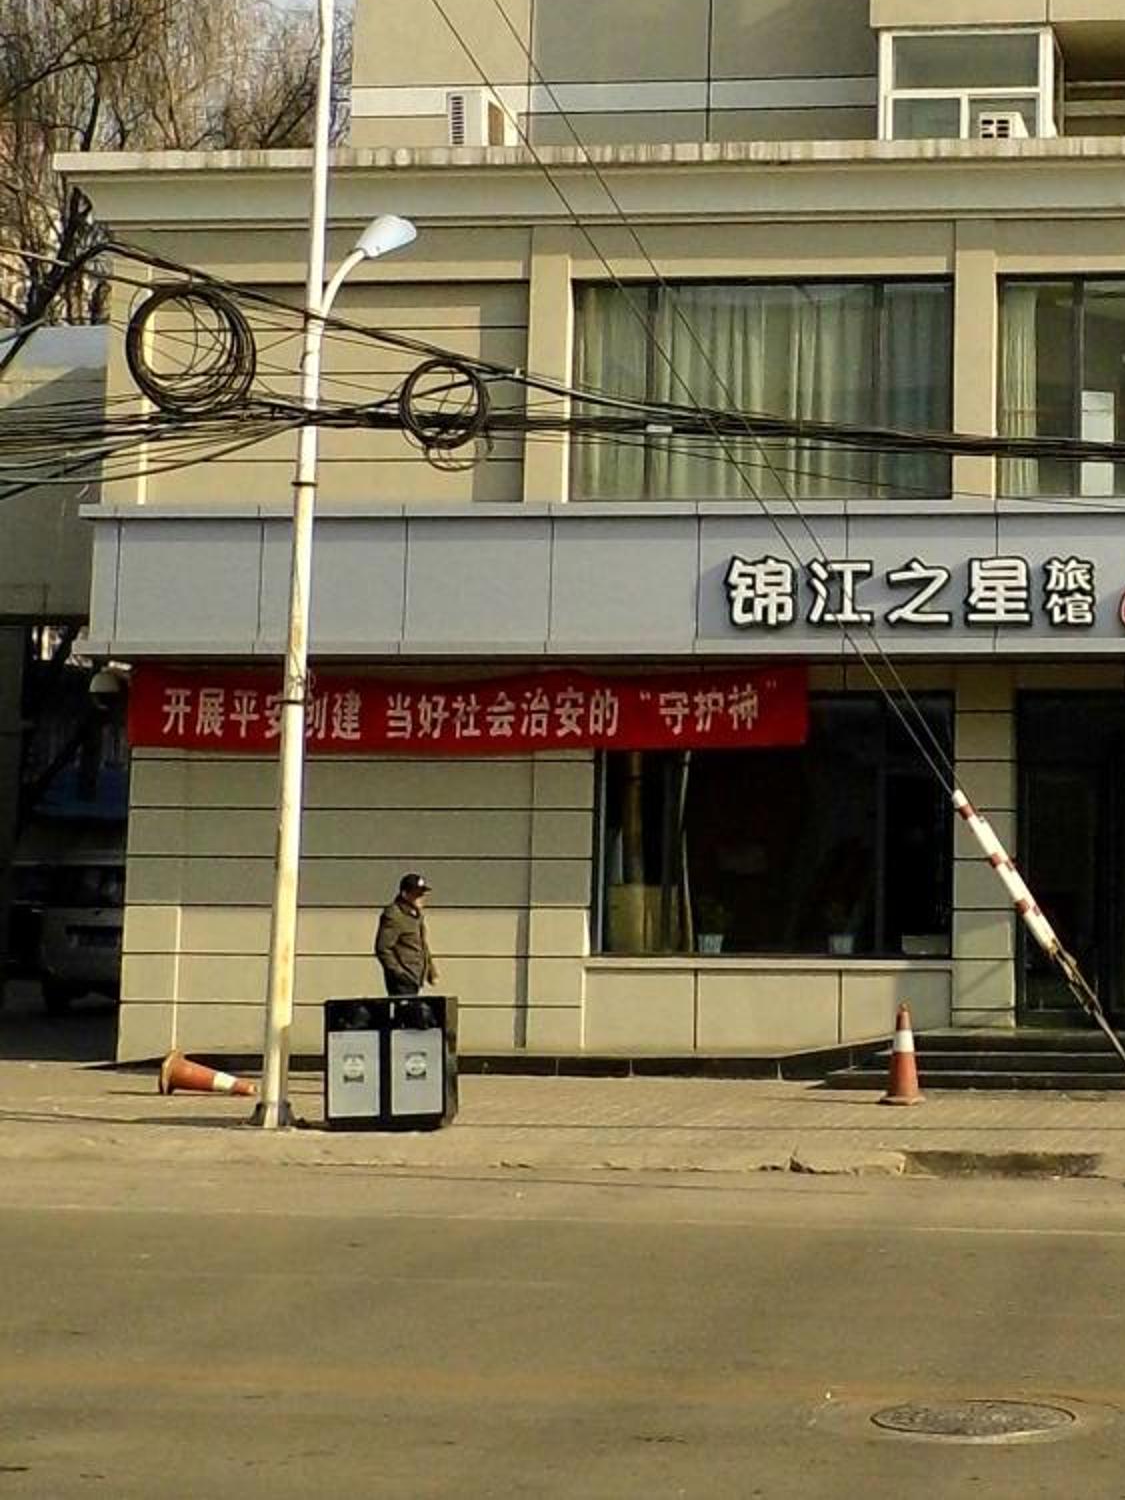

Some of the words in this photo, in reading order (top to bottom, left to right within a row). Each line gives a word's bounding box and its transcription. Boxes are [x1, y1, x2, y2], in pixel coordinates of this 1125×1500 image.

[727, 555, 1032, 627] 锦江之星
[1045, 555, 1094, 626] 旅馆
[386, 688, 618, 739] 当好社会治安的
